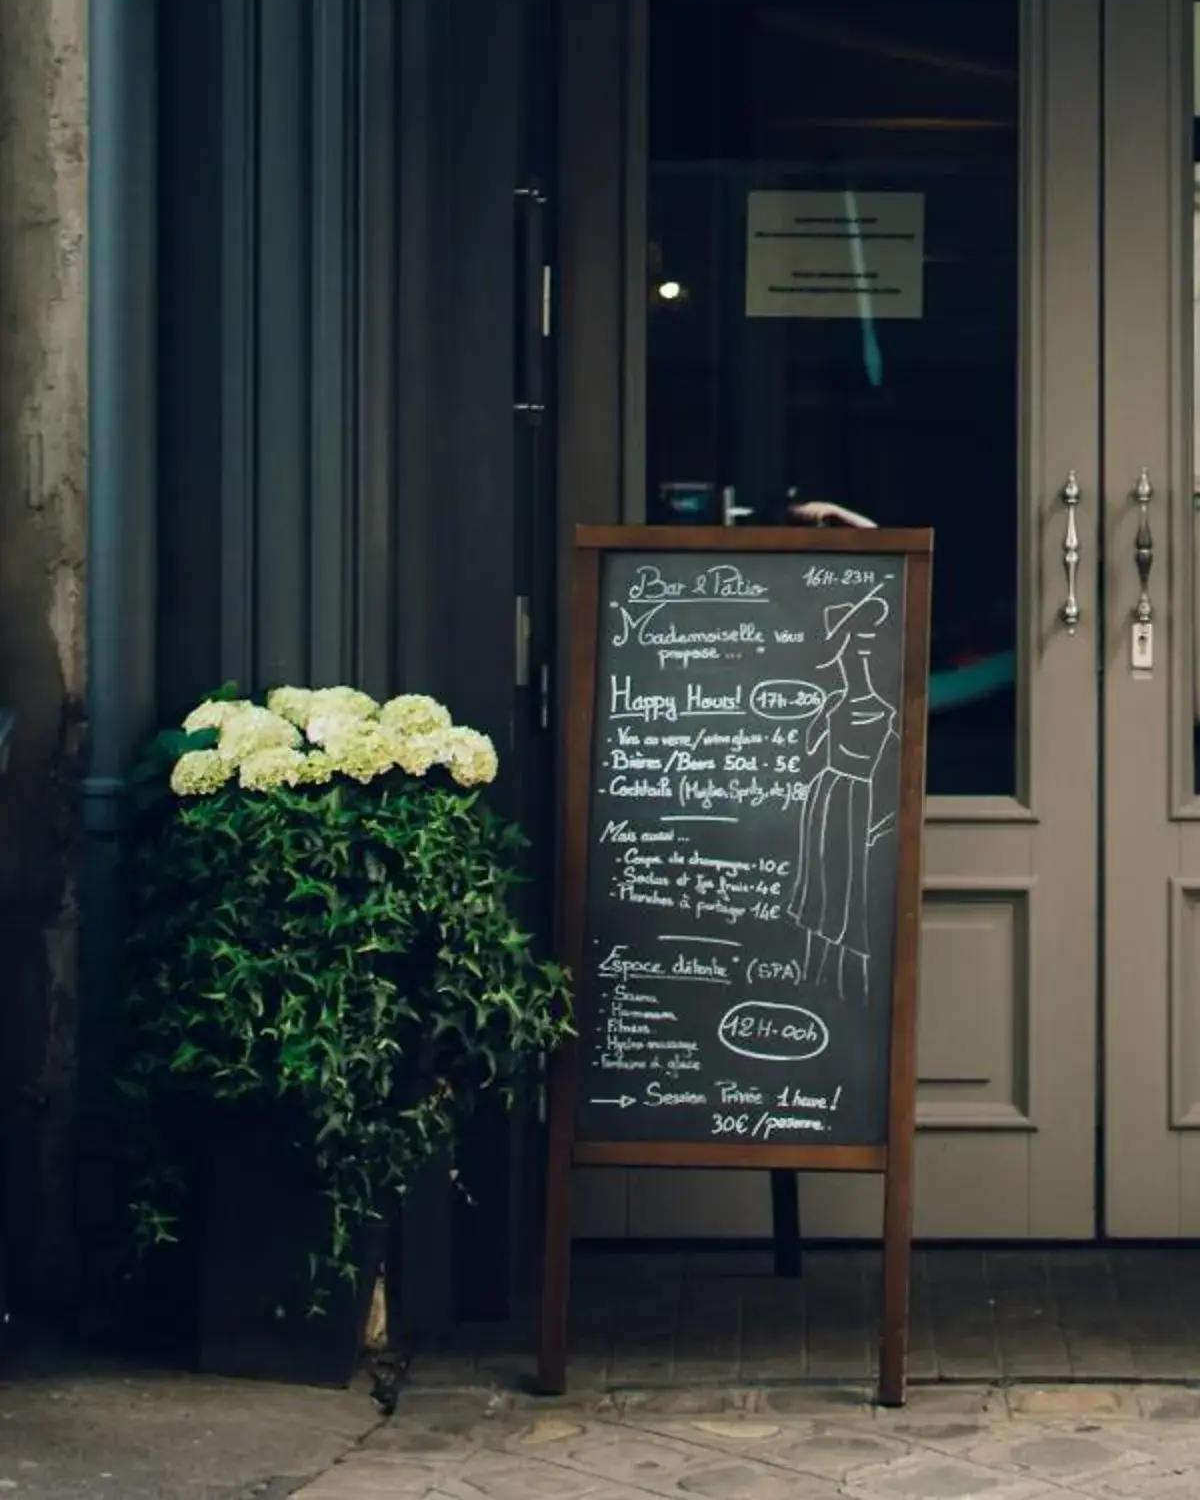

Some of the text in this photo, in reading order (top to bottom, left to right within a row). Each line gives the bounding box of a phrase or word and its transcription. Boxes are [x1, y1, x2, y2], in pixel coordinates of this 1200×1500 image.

[629, 565, 687, 599] Bar
[707, 564, 769, 597] Patio
[612, 601, 805, 647] Mademoiselle vous
[610, 674, 678, 722] Happy
[773, 755, 801, 773] 5€
[609, 775, 673, 797] Cocktails
[599, 820, 638, 843] Mais
[624, 847, 664, 869] Coupe
[668, 850, 684, 865] de
[759, 857, 790, 876] 10€
[624, 866, 670, 887] Sodas
[675, 871, 692, 887] et
[749, 901, 781, 921] 14€
[599, 945, 667, 982] Espace
[671, 952, 730, 978] détente
[613, 984, 660, 1005] Sauna
[611, 1001, 679, 1021] Hammam
[606, 1018, 652, 1035] Fitness
[643, 1081, 708, 1106] Session
[714, 1080, 764, 1105] Privée
